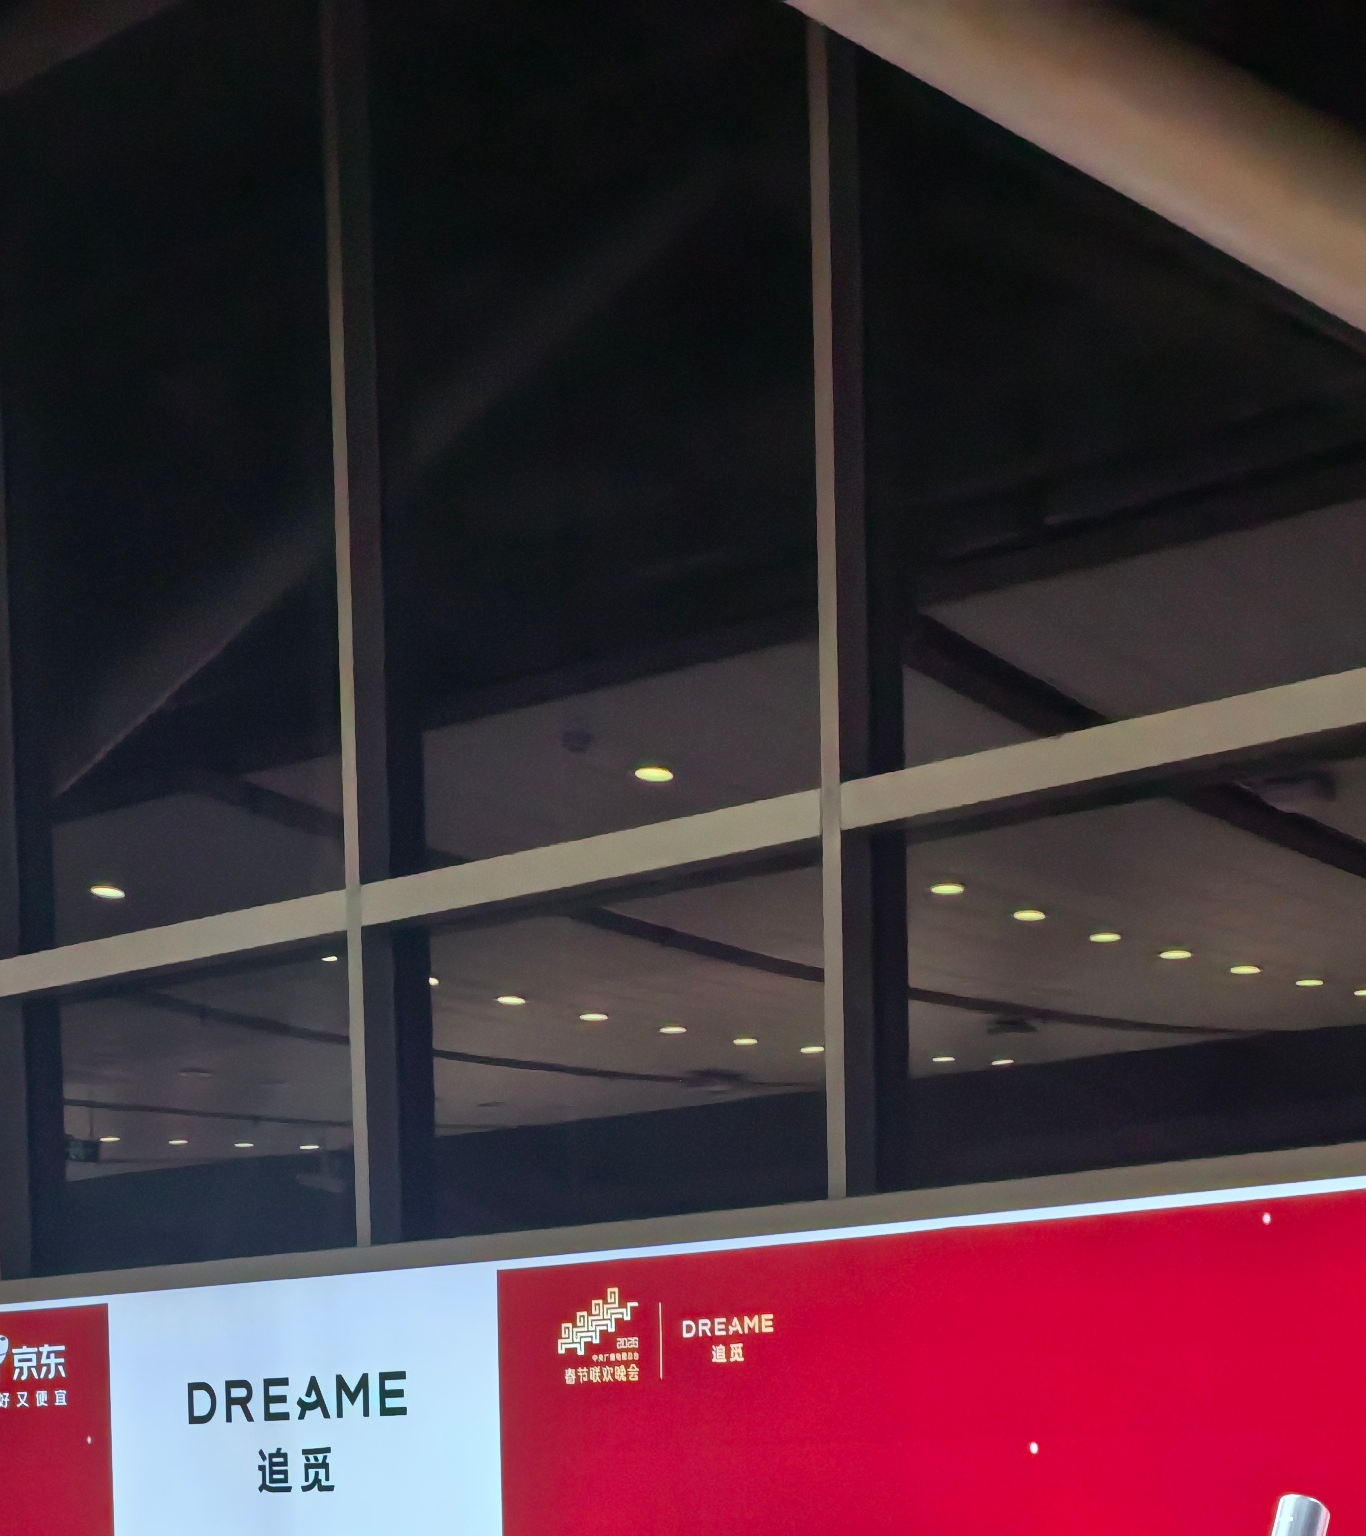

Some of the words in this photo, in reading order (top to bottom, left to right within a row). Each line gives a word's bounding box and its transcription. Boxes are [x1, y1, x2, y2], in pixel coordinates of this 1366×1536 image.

[683, 1314, 773, 1338] DREAME
[12, 1344, 66, 1380] 京东
[712, 1343, 744, 1362] 追觅
[565, 1364, 639, 1384] 春节联欢晚会
[188, 1371, 407, 1424] DREAME
[258, 1447, 334, 1492] 追觅
